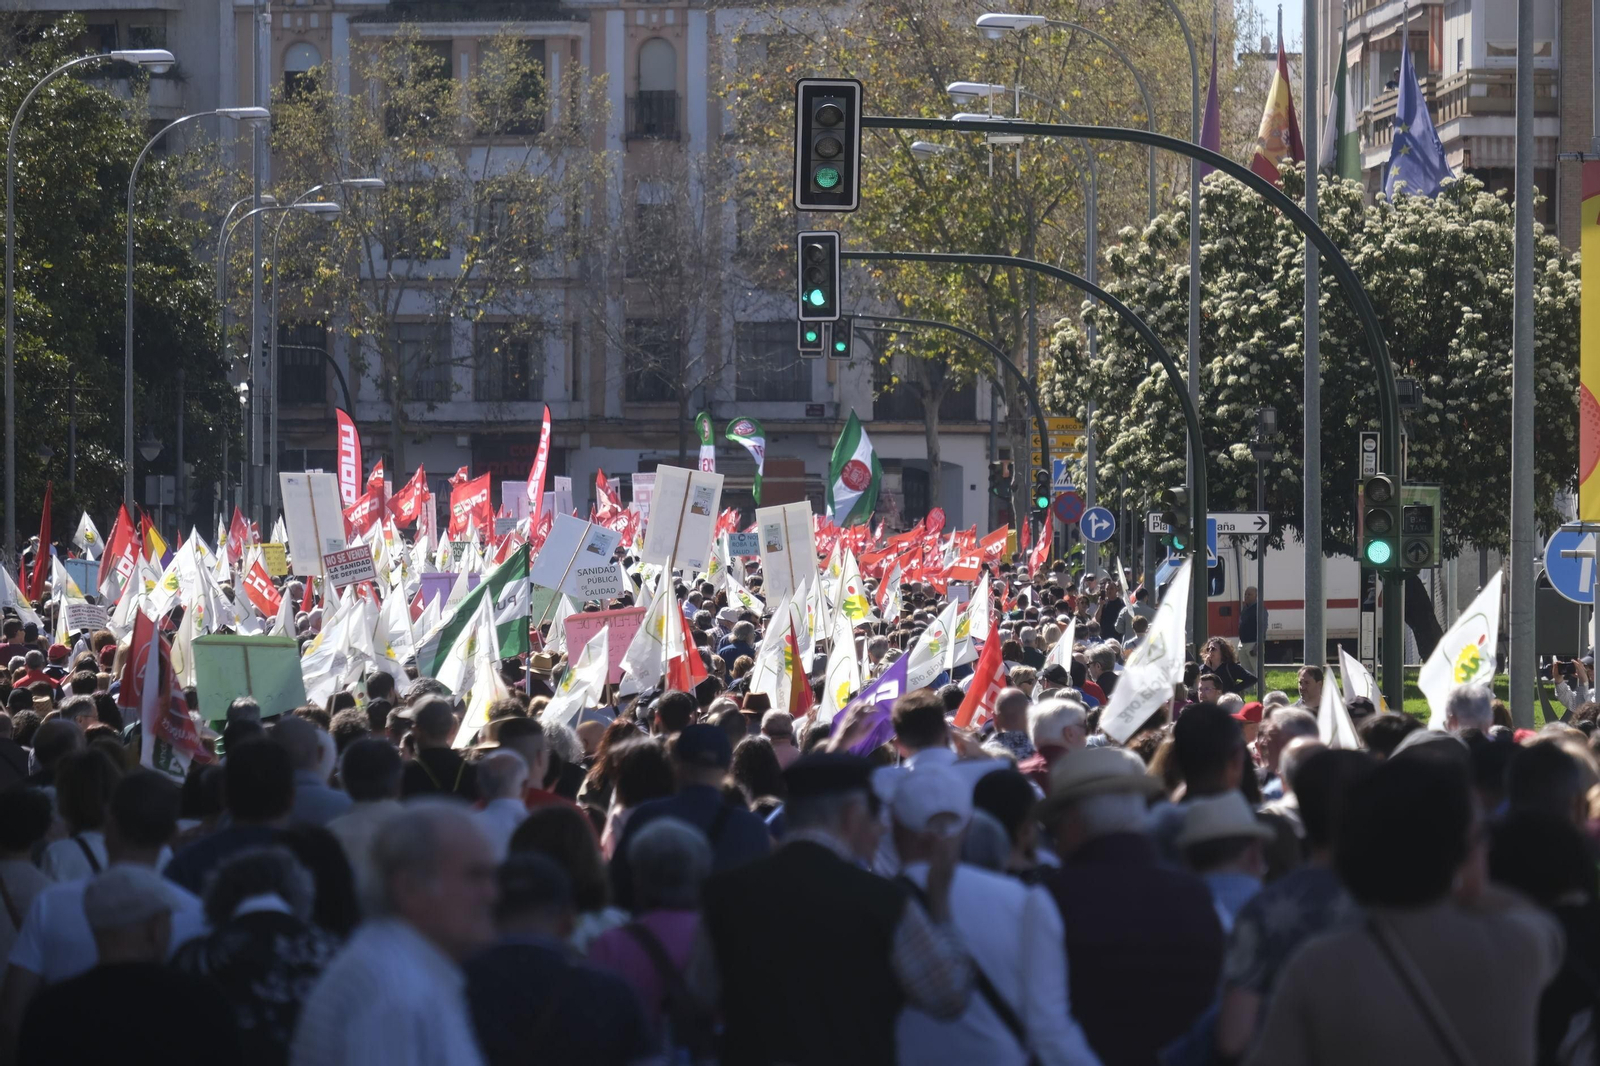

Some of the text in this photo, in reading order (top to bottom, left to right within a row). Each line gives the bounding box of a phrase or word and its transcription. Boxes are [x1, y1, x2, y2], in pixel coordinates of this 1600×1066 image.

[326, 546, 370, 566] NO SE VENDE
[340, 558, 371, 571] SANIDAD
[330, 566, 372, 580] SE DEFIENDE
[577, 566, 616, 577] SANIDAD
[588, 575, 618, 584] PÚBLICA
[585, 588, 616, 597] CALIDAD
